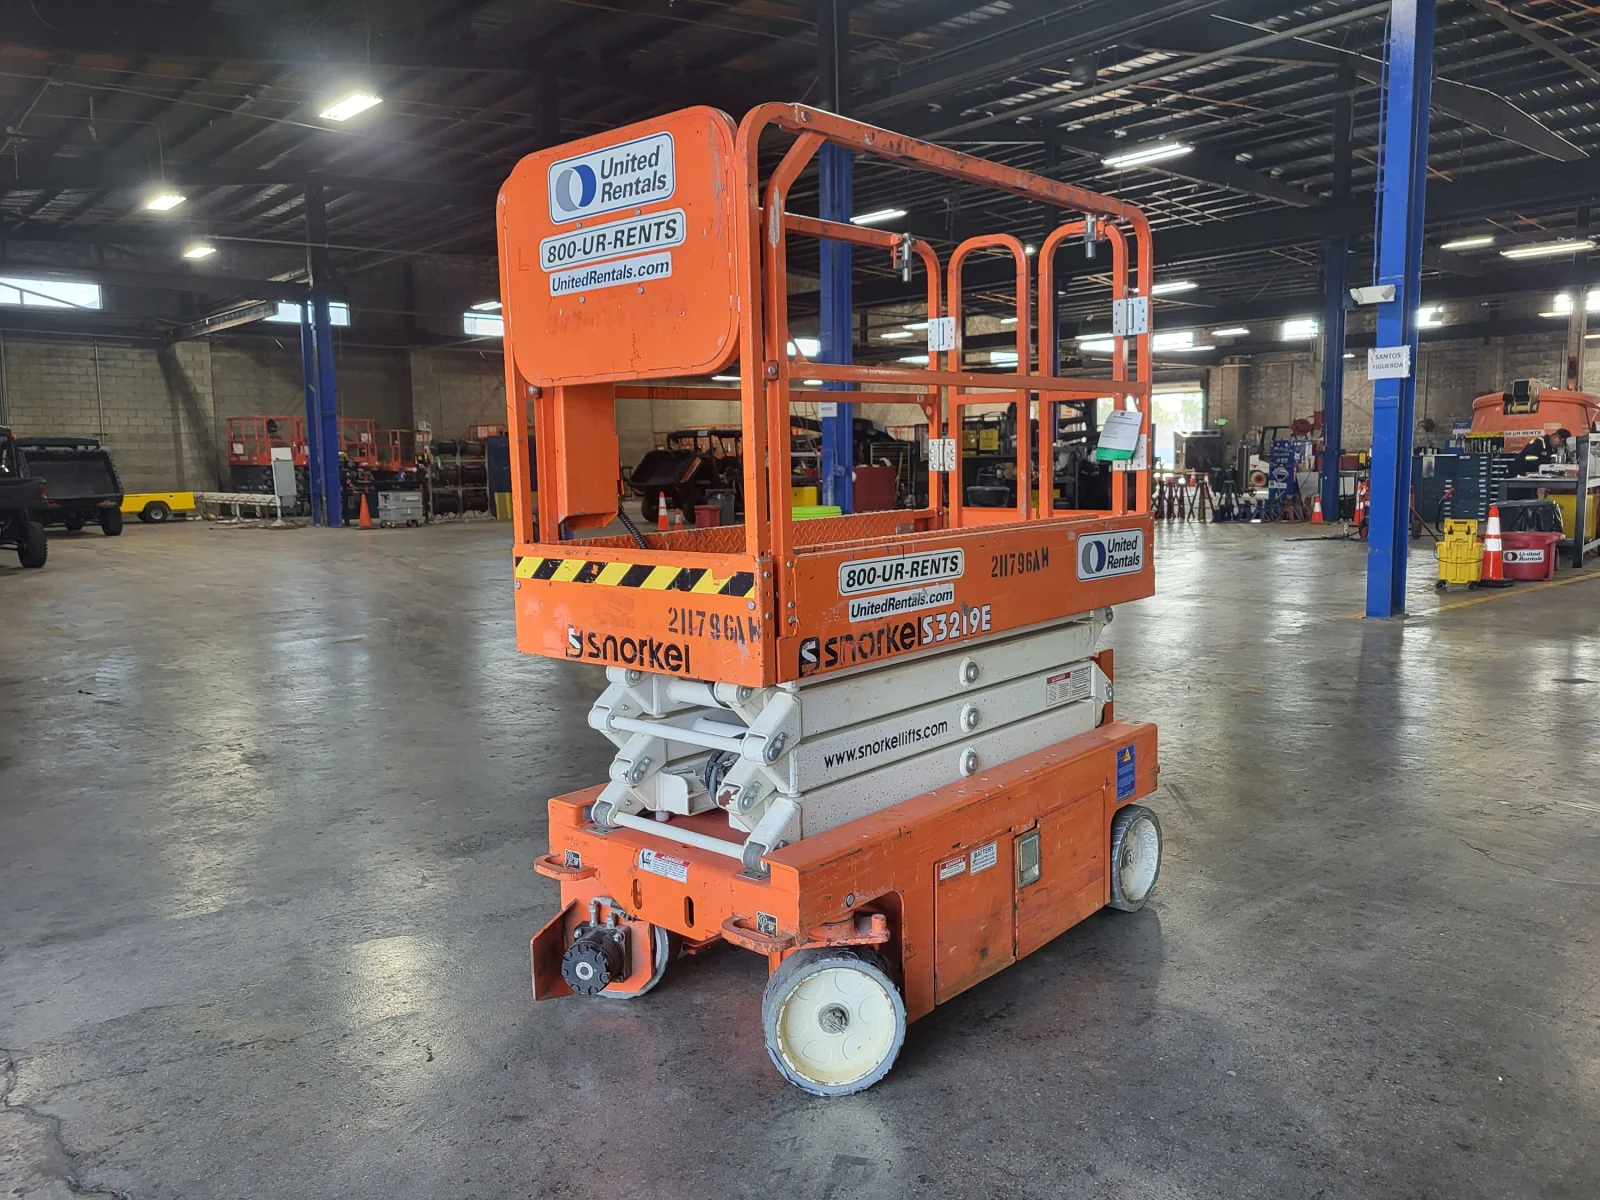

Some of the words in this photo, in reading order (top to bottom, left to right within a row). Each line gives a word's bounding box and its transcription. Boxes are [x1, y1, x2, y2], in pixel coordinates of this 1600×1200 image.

[600, 145, 660, 179] United
[600, 170, 667, 203] Rentals
[547, 218, 677, 263] 800-UR-RENTS
[552, 260, 669, 292] UnitedRentals.com
[1372, 362, 1404, 370] FIGUEROA
[1375, 352, 1401, 360] SANTOS
[1107, 535, 1139, 553] United
[846, 555, 959, 588] 800-UR-RENTS
[1107, 552, 1140, 570] Rentals
[851, 589, 953, 618] UnitedRentals.com
[824, 616, 921, 668] snorkel
[922, 603, 991, 646] S3219E
[587, 632, 691, 675] snorkel
[824, 720, 948, 768] www.snorkellifts.com
[973, 846, 994, 858] BATTERY
